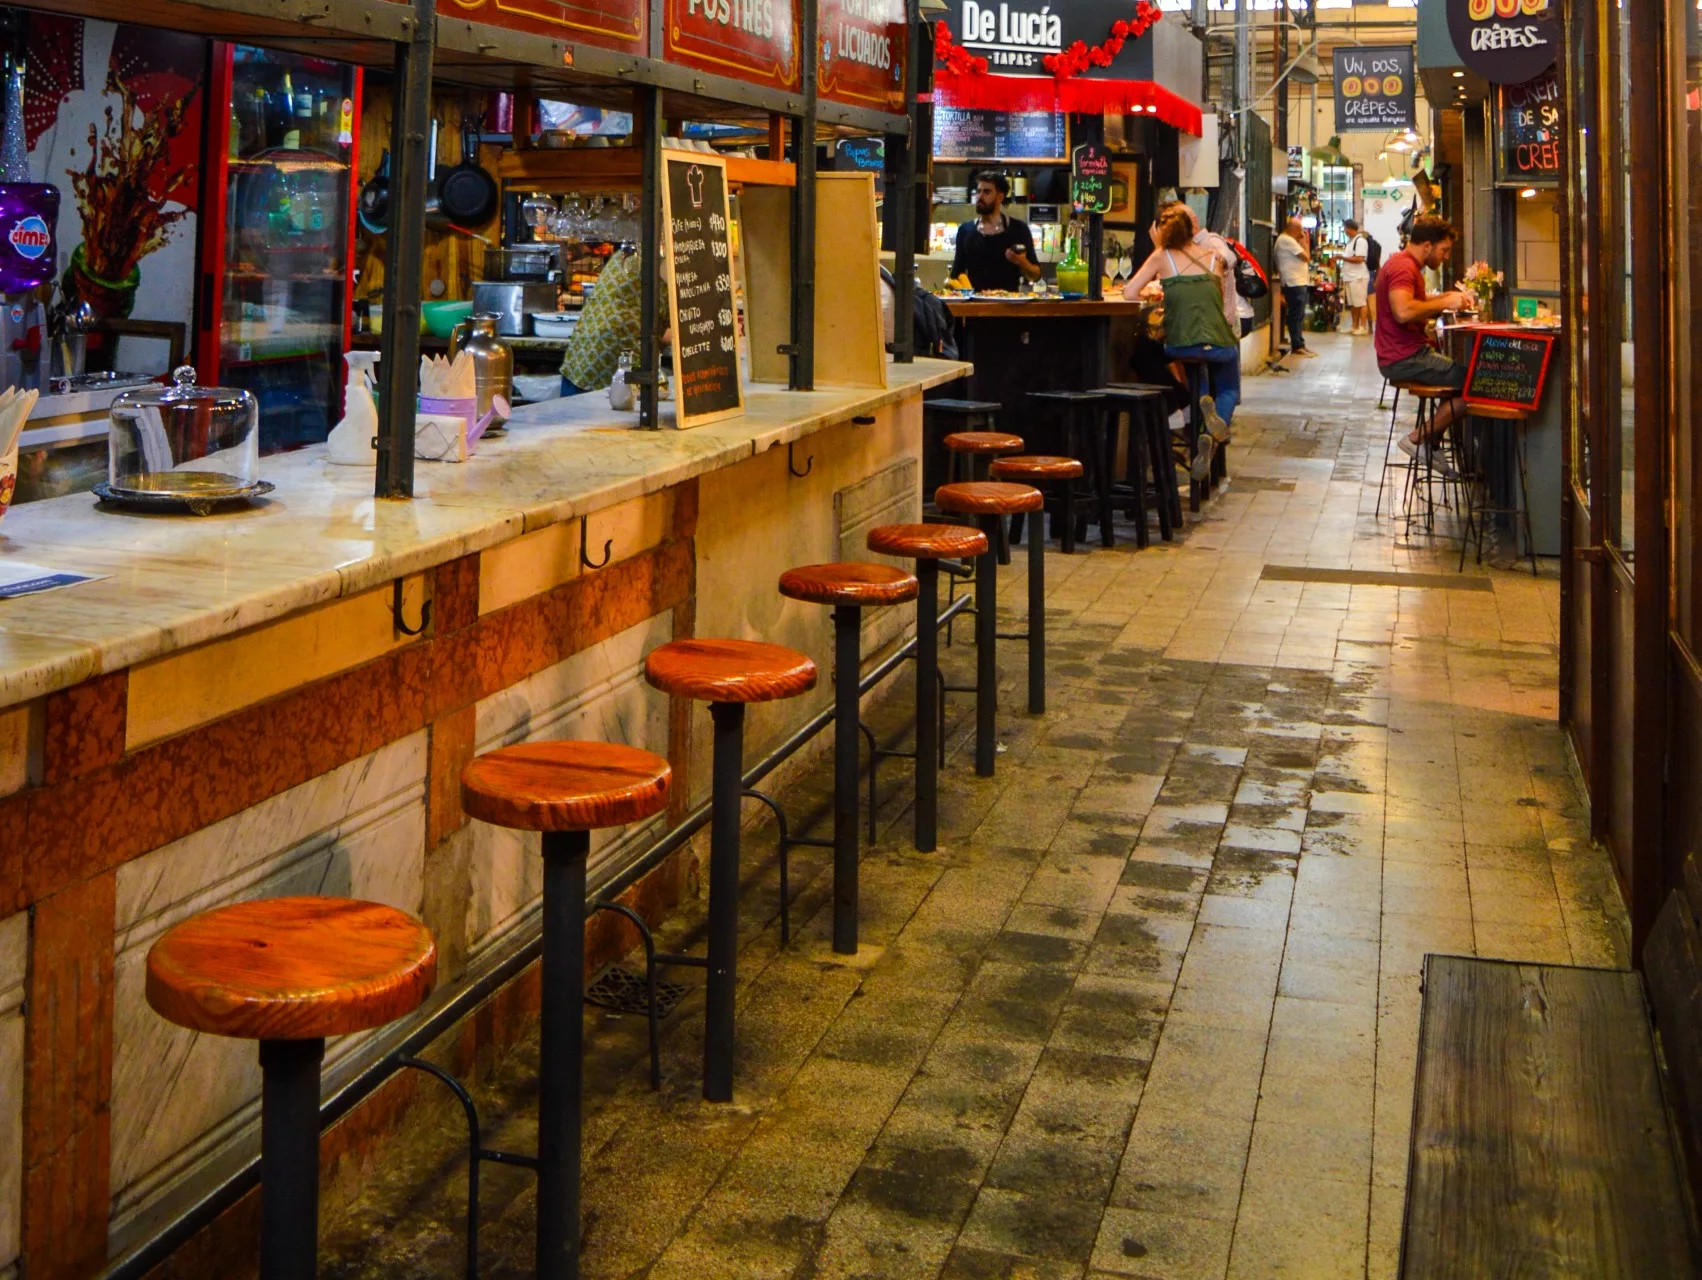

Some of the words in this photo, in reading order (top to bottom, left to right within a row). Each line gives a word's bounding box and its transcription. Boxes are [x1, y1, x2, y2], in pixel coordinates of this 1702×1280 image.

[961, 0, 995, 42] De
[999, 2, 1062, 47] Lucía
[838, 22, 891, 70] LICUADOS
[1372, 58, 1403, 75] DOS,
[1518, 109, 1535, 127] DE
